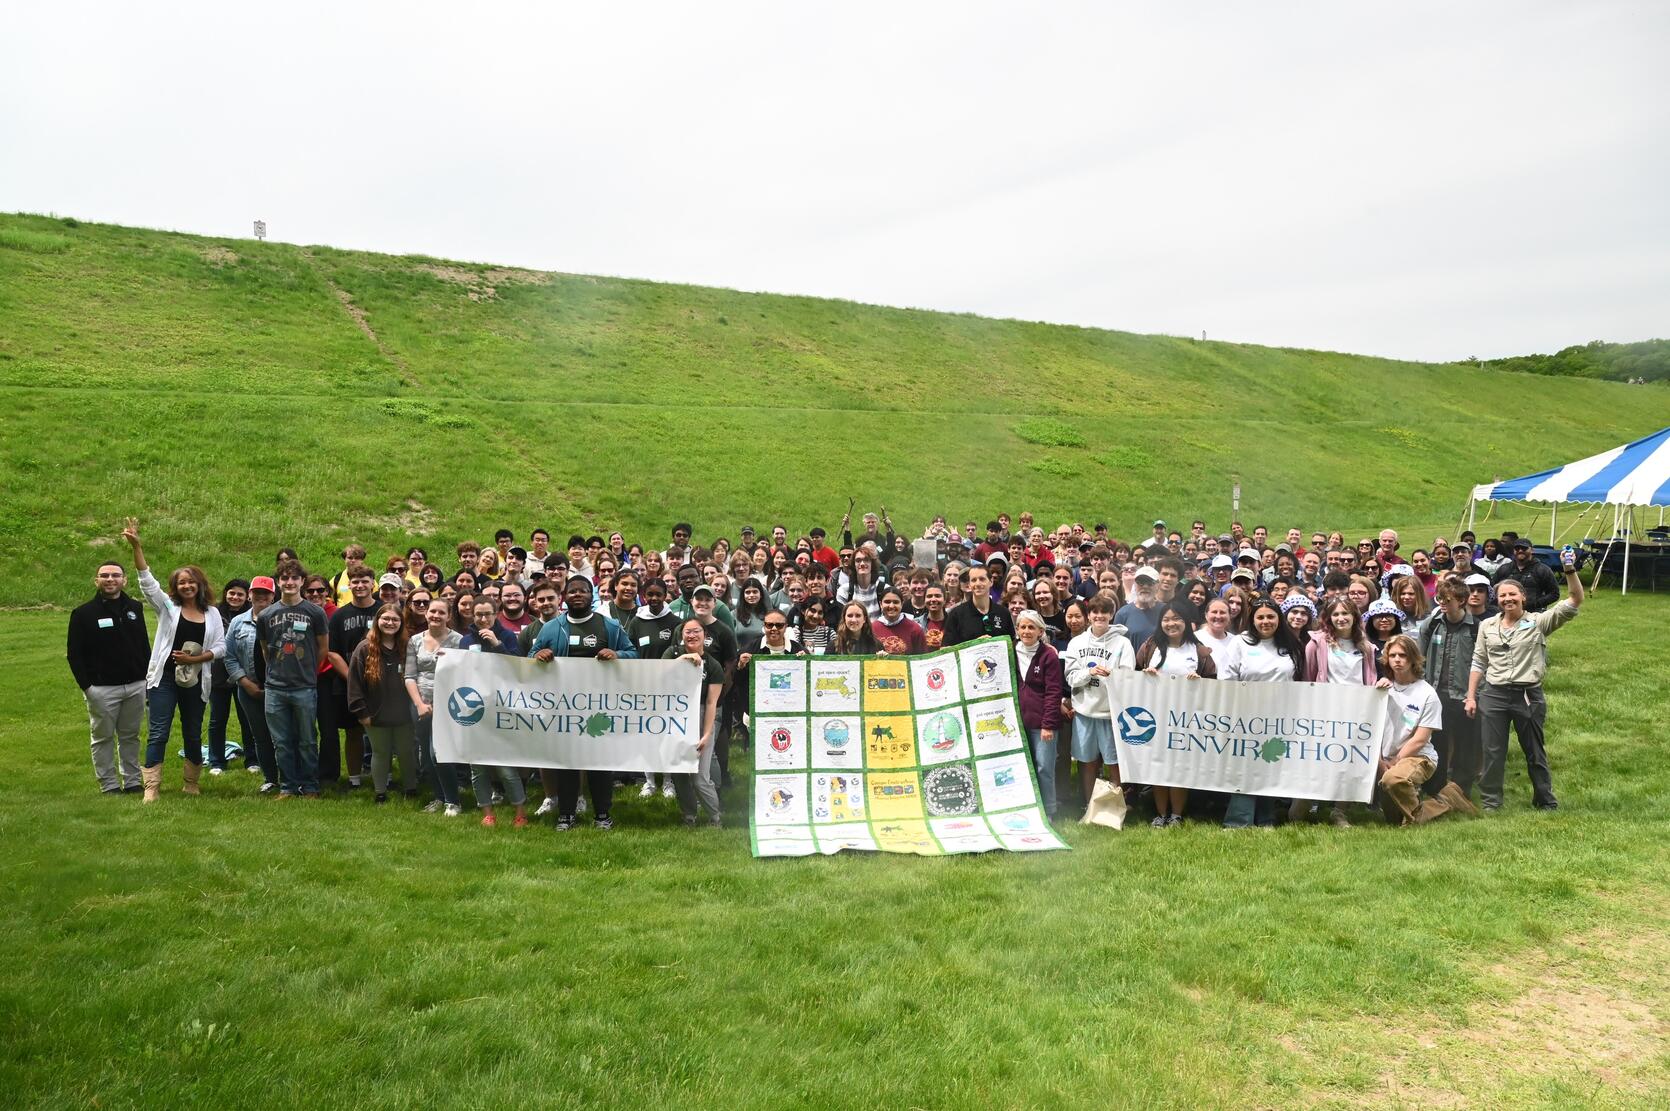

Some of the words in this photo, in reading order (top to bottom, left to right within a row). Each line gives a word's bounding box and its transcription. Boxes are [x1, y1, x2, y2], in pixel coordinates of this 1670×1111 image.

[269, 612, 311, 628] CLASSIC
[343, 615, 375, 631] HOLY
[495, 690, 689, 712] MASSACHUSETTS
[496, 711, 688, 738] ENVIRTHON
[1168, 710, 1372, 741] MASSACHUSETTS
[1167, 731, 1371, 765] ENVIRTHON
